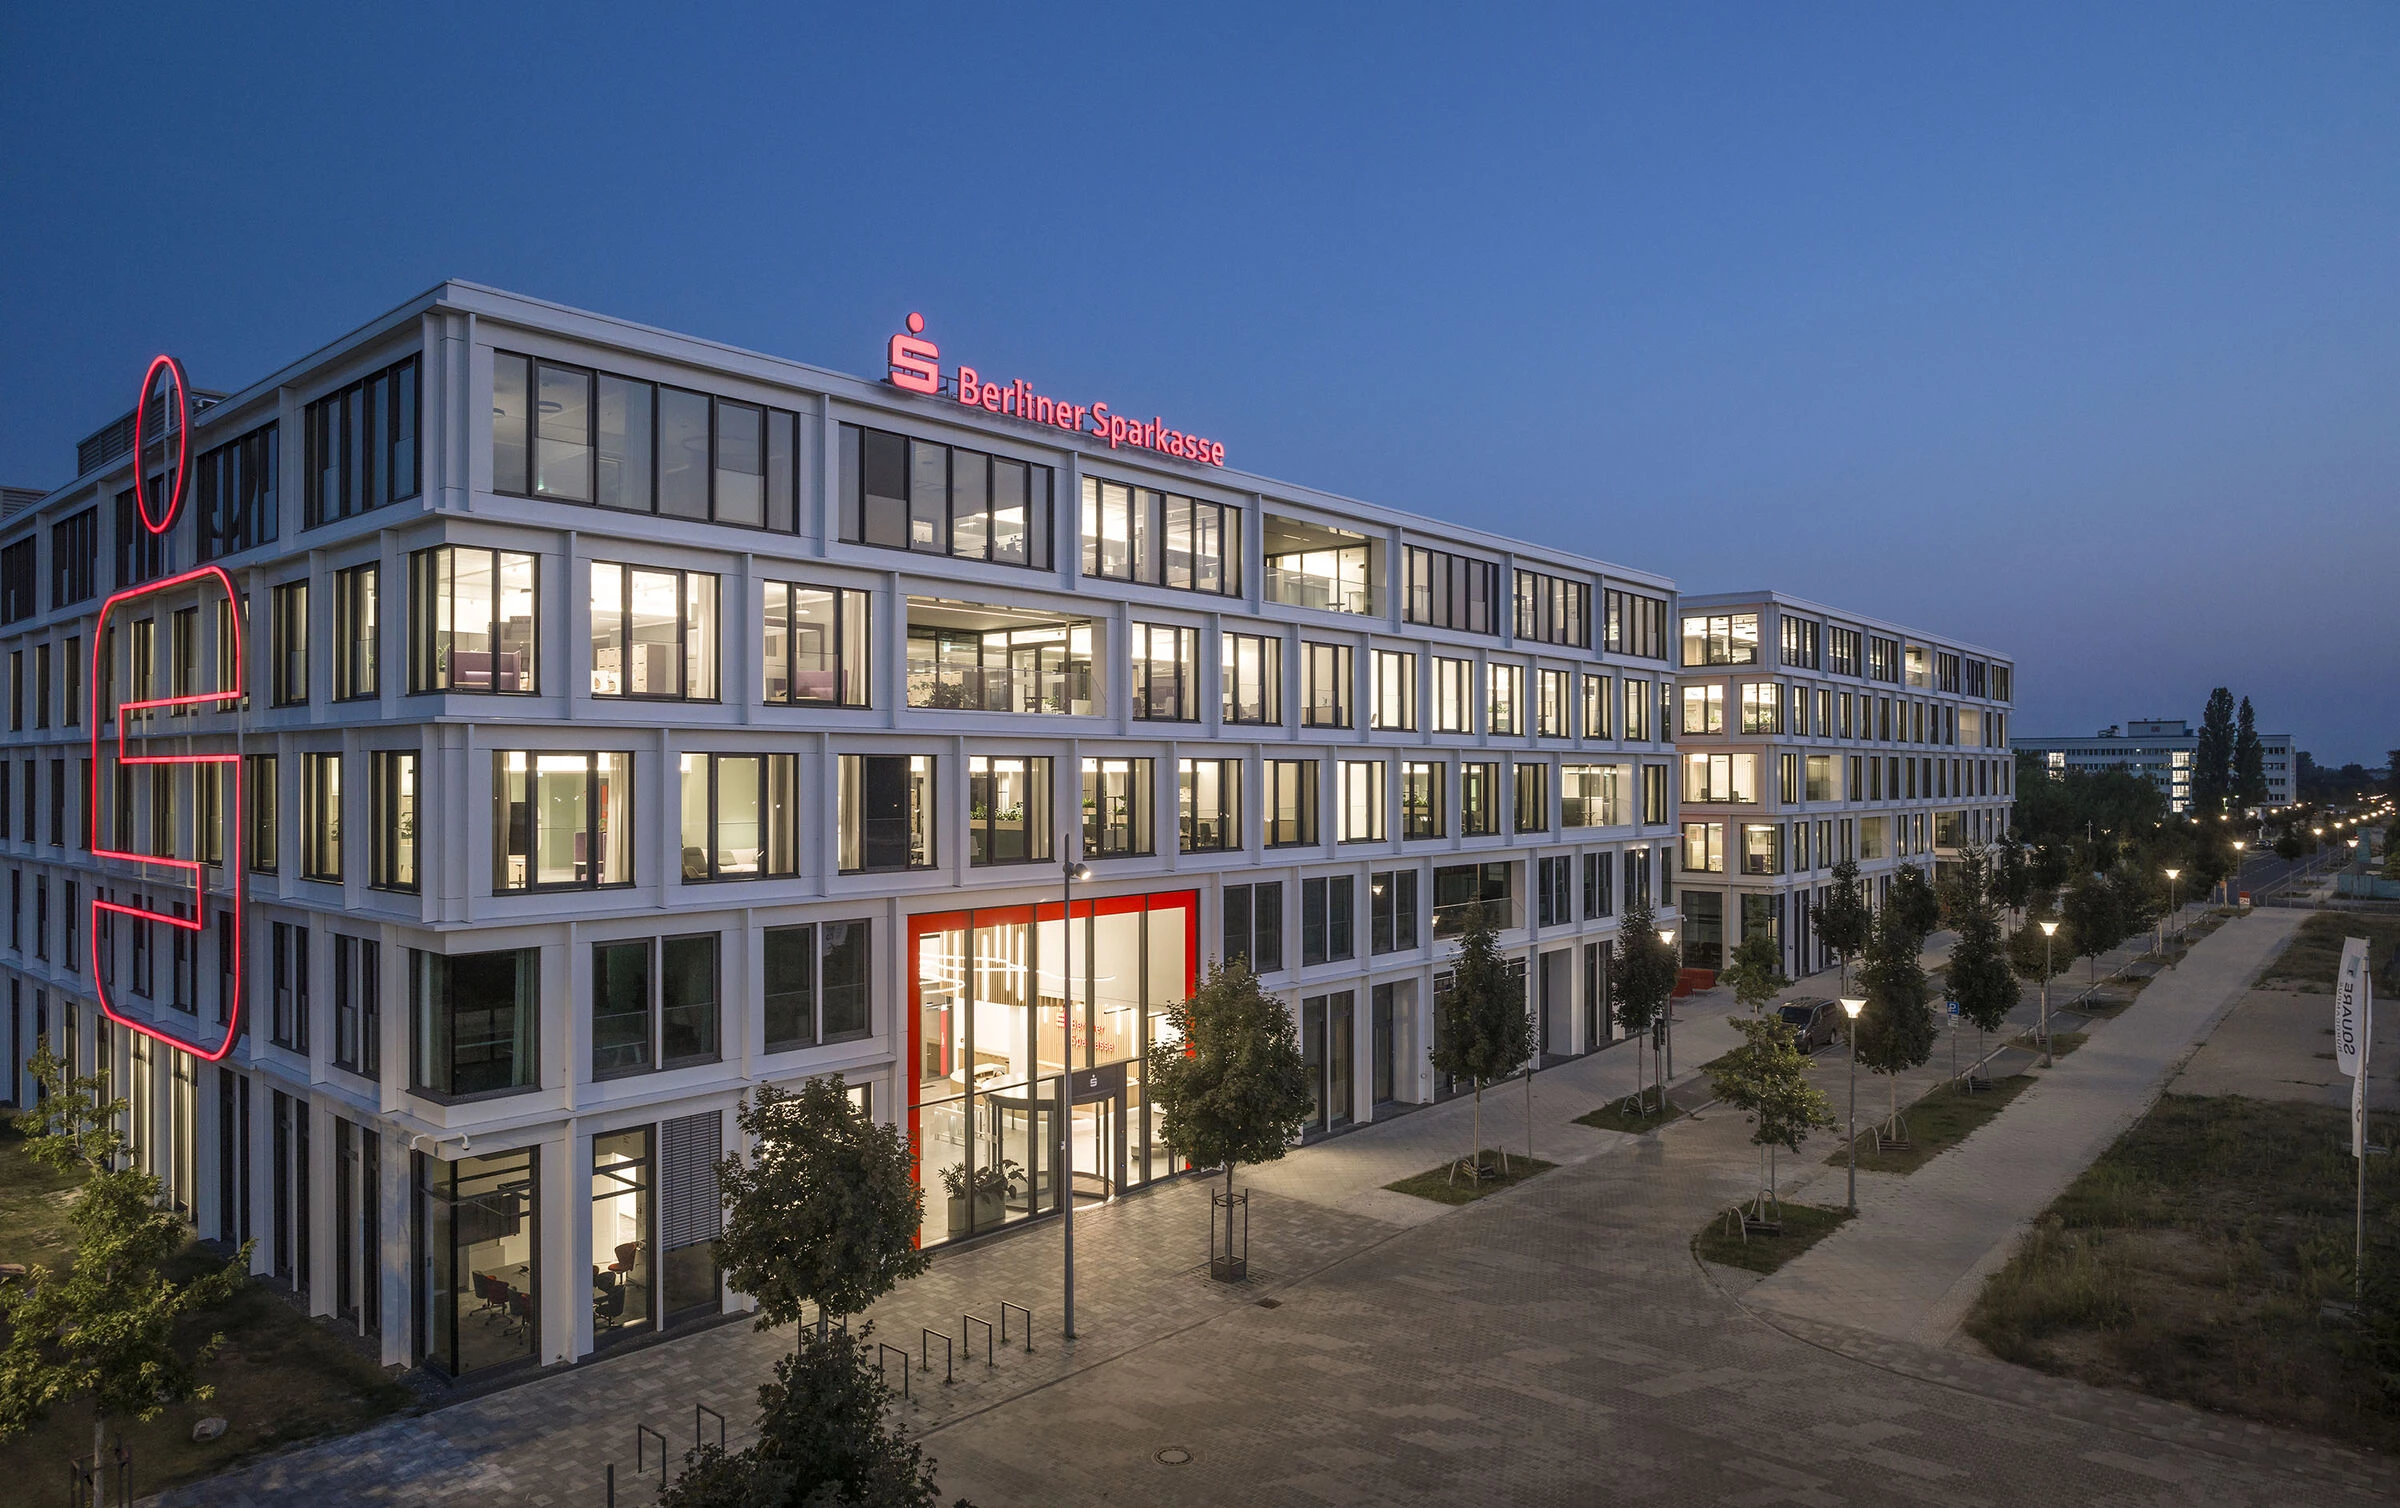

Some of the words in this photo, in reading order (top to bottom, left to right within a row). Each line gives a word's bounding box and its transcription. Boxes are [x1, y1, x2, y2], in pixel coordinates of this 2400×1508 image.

[957, 366, 1086, 431] Berliner
[1090, 402, 1225, 467] Sparkasse
[1071, 1035, 1114, 1051] Spaasse
